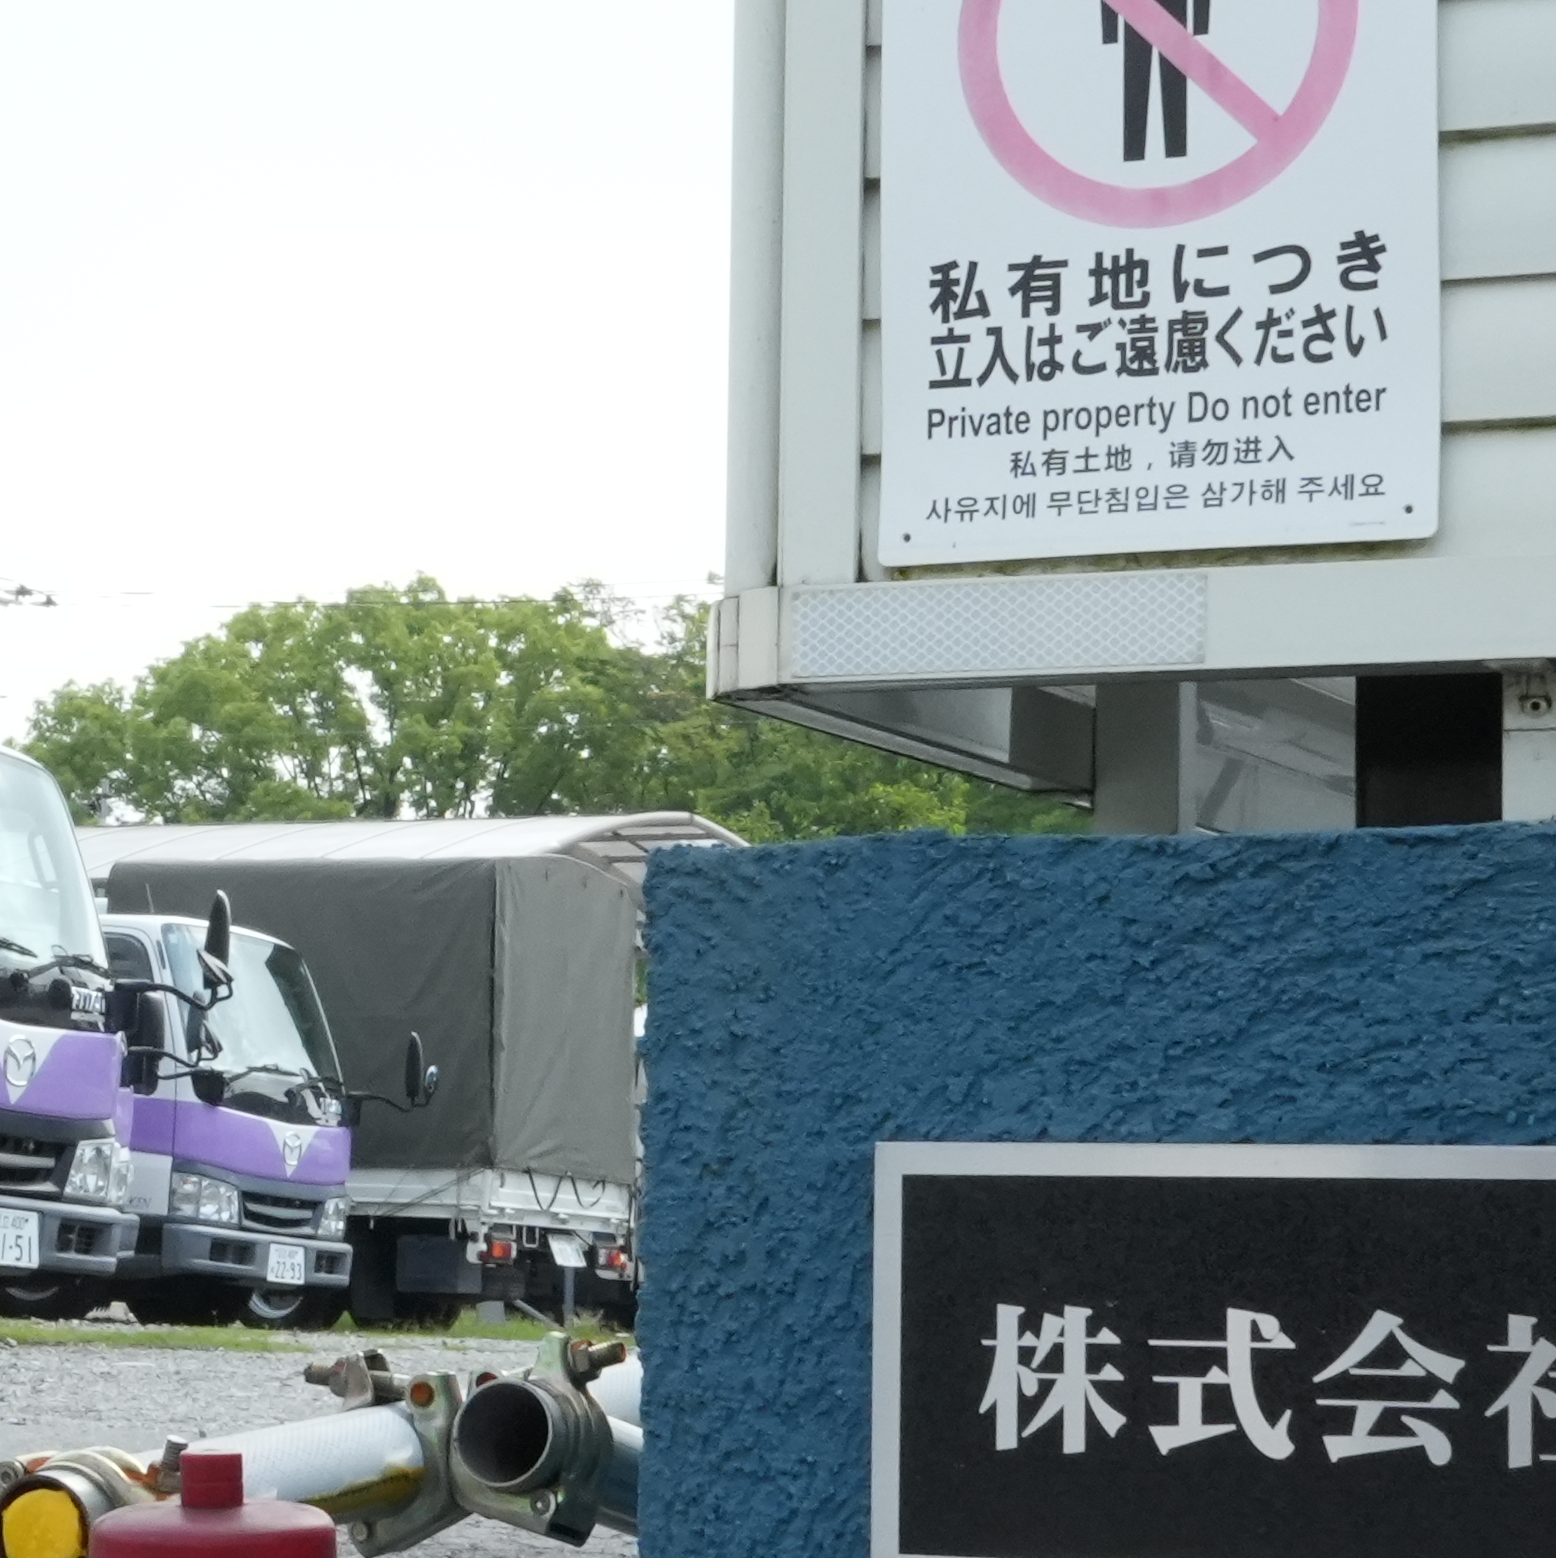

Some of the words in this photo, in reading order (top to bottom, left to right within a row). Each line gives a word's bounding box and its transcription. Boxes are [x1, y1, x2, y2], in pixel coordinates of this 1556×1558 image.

[928, 229, 1387, 323] 私有地につき
[928, 303, 1388, 389] 立入はご遠慮ください
[926, 406, 1031, 440] Private
[1042, 394, 1176, 442] property
[1188, 391, 1229, 423] Do
[1242, 386, 1292, 419] not
[1303, 382, 1387, 416] enter
[925, 492, 1037, 524] 사유지에
[1046, 482, 1190, 518] 무단침입은
[1200, 477, 1287, 509] 삼가해
[1296, 473, 1387, 503] 주세요
